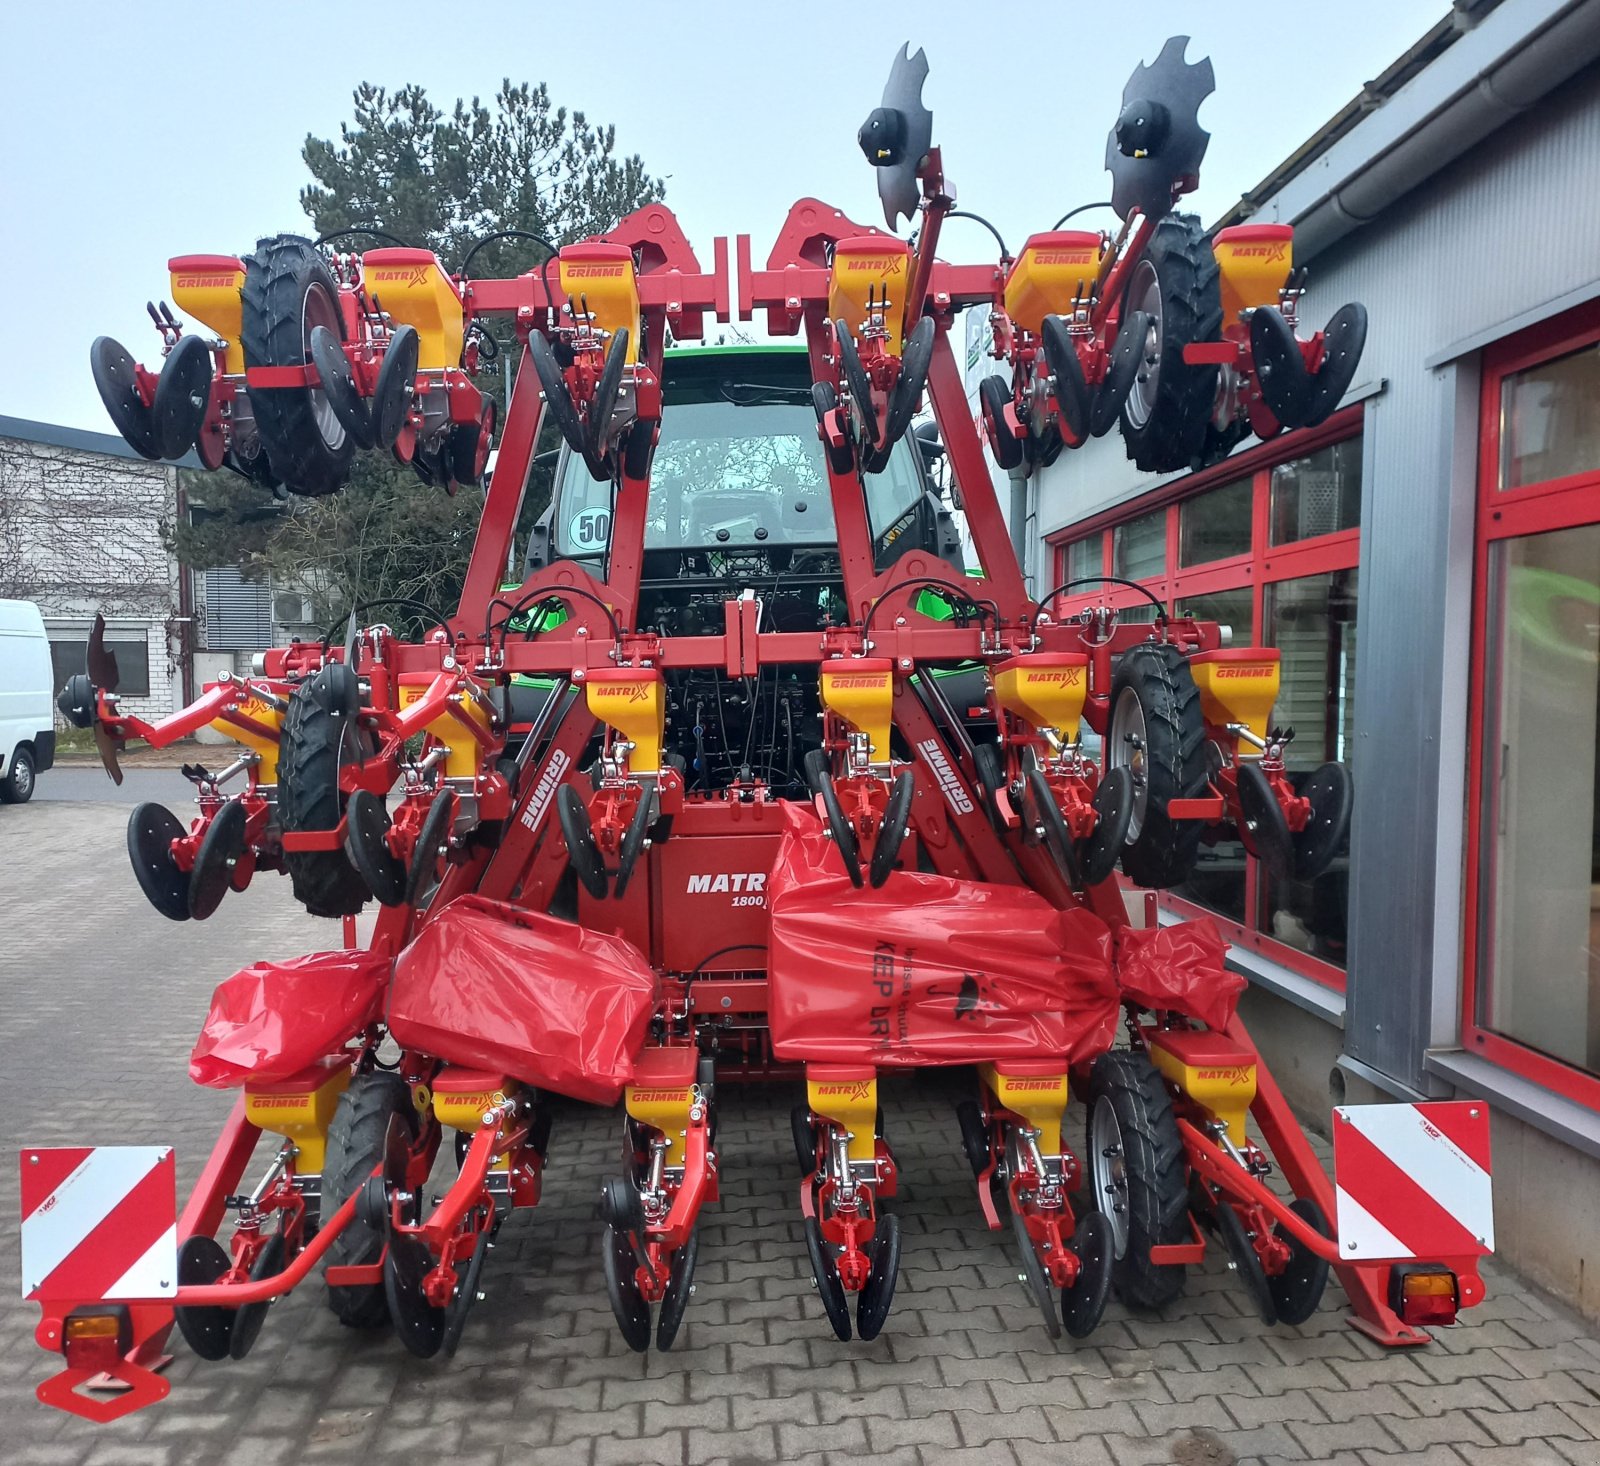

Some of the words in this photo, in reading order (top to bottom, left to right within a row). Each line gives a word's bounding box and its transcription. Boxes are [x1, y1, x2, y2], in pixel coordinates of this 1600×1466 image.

[1034, 251, 1092, 265] GRIMME
[1232, 242, 1285, 264] MATRIX
[566, 264, 624, 277] GRIMME
[847, 255, 901, 277] MATRIX
[176, 274, 234, 288] GRIMME
[375, 267, 428, 288] MATRIX
[580, 514, 609, 543] 50
[831, 675, 887, 688] GRIMME
[1026, 668, 1080, 689] MATRIX
[1215, 664, 1273, 678] GRIMME
[596, 682, 649, 703] MATRIX
[916, 738, 975, 815] GRIMME
[521, 748, 571, 832] GRIMME
[686, 872, 767, 893] MATR
[731, 896, 763, 907] 1800
[872, 939, 897, 997] KEEP
[1005, 1078, 1062, 1091] GRIMME
[1197, 1065, 1251, 1087] MATRIX
[252, 1095, 311, 1108] GRIMME
[631, 1089, 689, 1102] GRIMME
[818, 1081, 871, 1102] MATRIX
